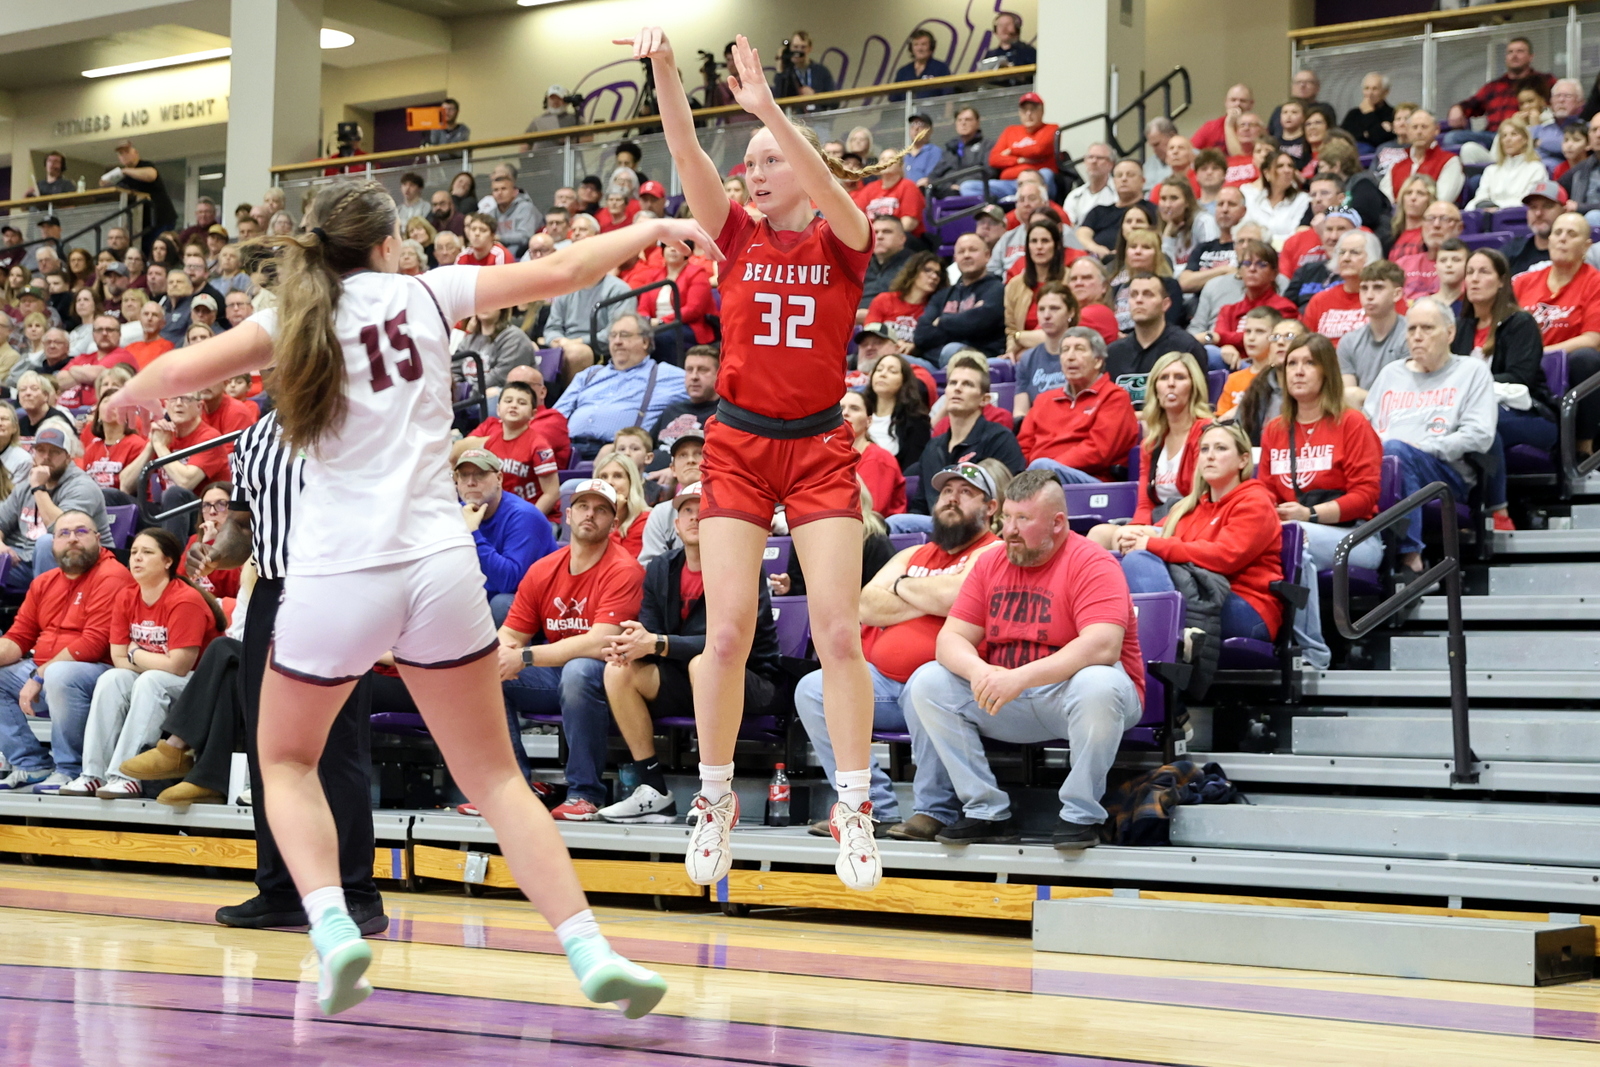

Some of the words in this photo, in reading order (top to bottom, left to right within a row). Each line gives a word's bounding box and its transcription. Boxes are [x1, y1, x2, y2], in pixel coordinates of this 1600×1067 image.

[121, 109, 150, 128] AND
[160, 99, 215, 122] WEIGHT
[742, 262, 831, 285] BELLEVUE
[753, 292, 816, 349] 32
[359, 309, 424, 393] 15
[1379, 389, 1416, 433] OHIO
[1416, 387, 1457, 409] STATE
[1270, 444, 1334, 461] BELEVUE
[1094, 496, 1105, 506] 41
[765, 548, 776, 557] 39
[989, 591, 1052, 624] STATE
[546, 617, 592, 631] BASBALL
[990, 625, 1000, 637] 20
[1037, 630, 1048, 641] 25
[986, 640, 1061, 669] FINAL
[1178, 742, 1184, 753] A
